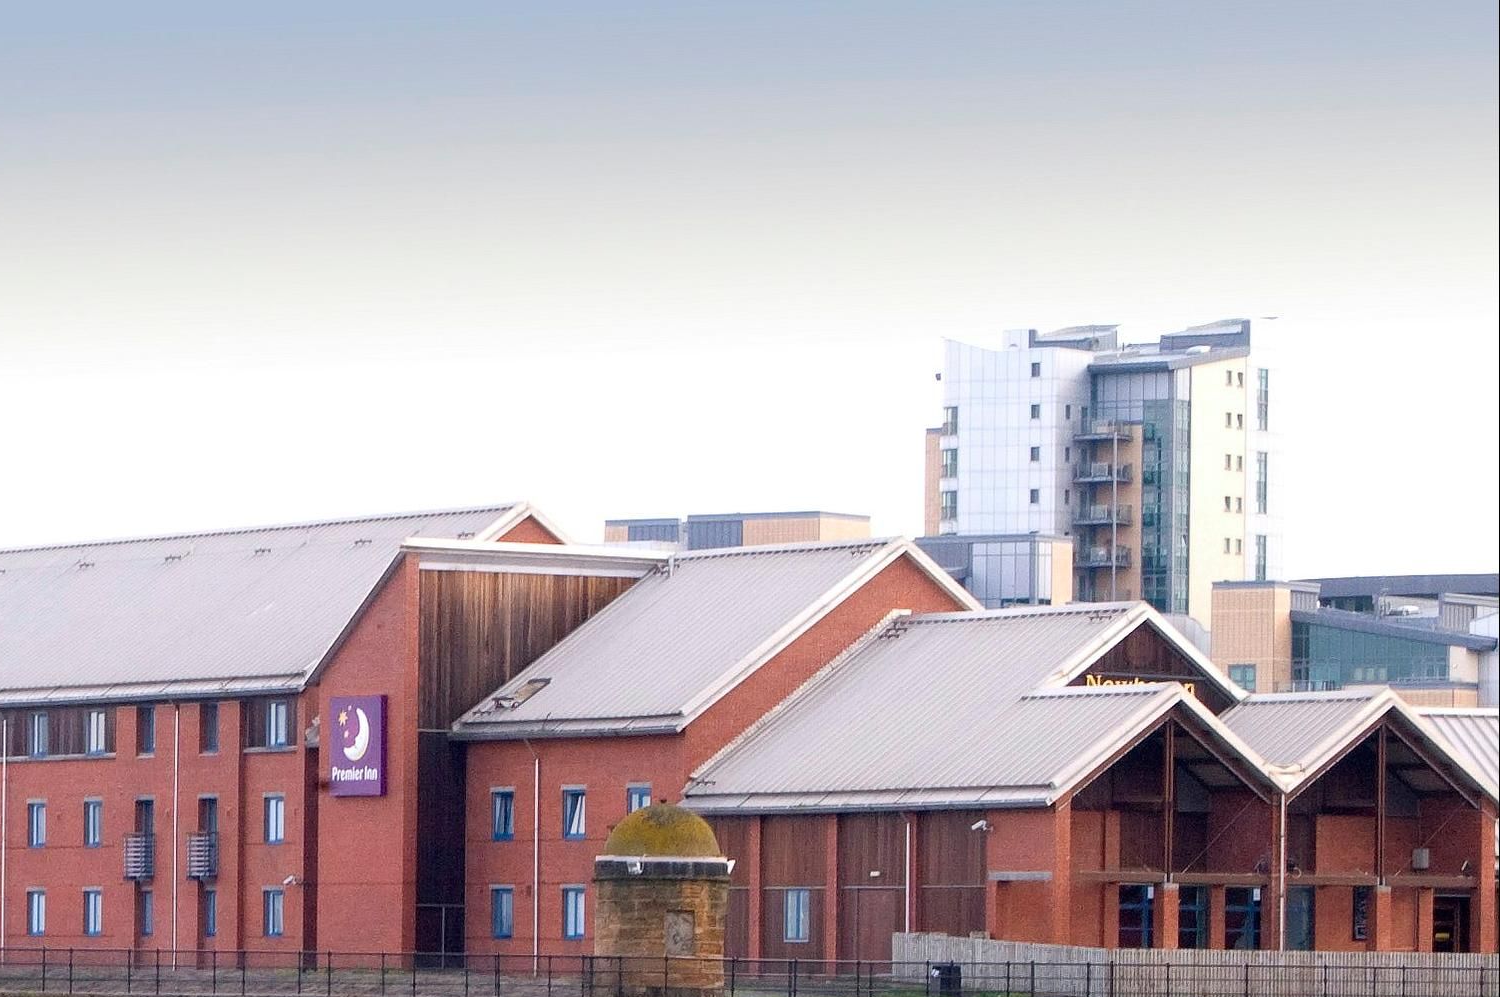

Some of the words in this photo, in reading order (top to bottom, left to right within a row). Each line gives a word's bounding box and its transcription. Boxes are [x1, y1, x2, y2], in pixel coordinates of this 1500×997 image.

[1086, 674, 1196, 696] Newhn
[332, 766, 364, 781] Premier
[364, 765, 378, 781] Inn
